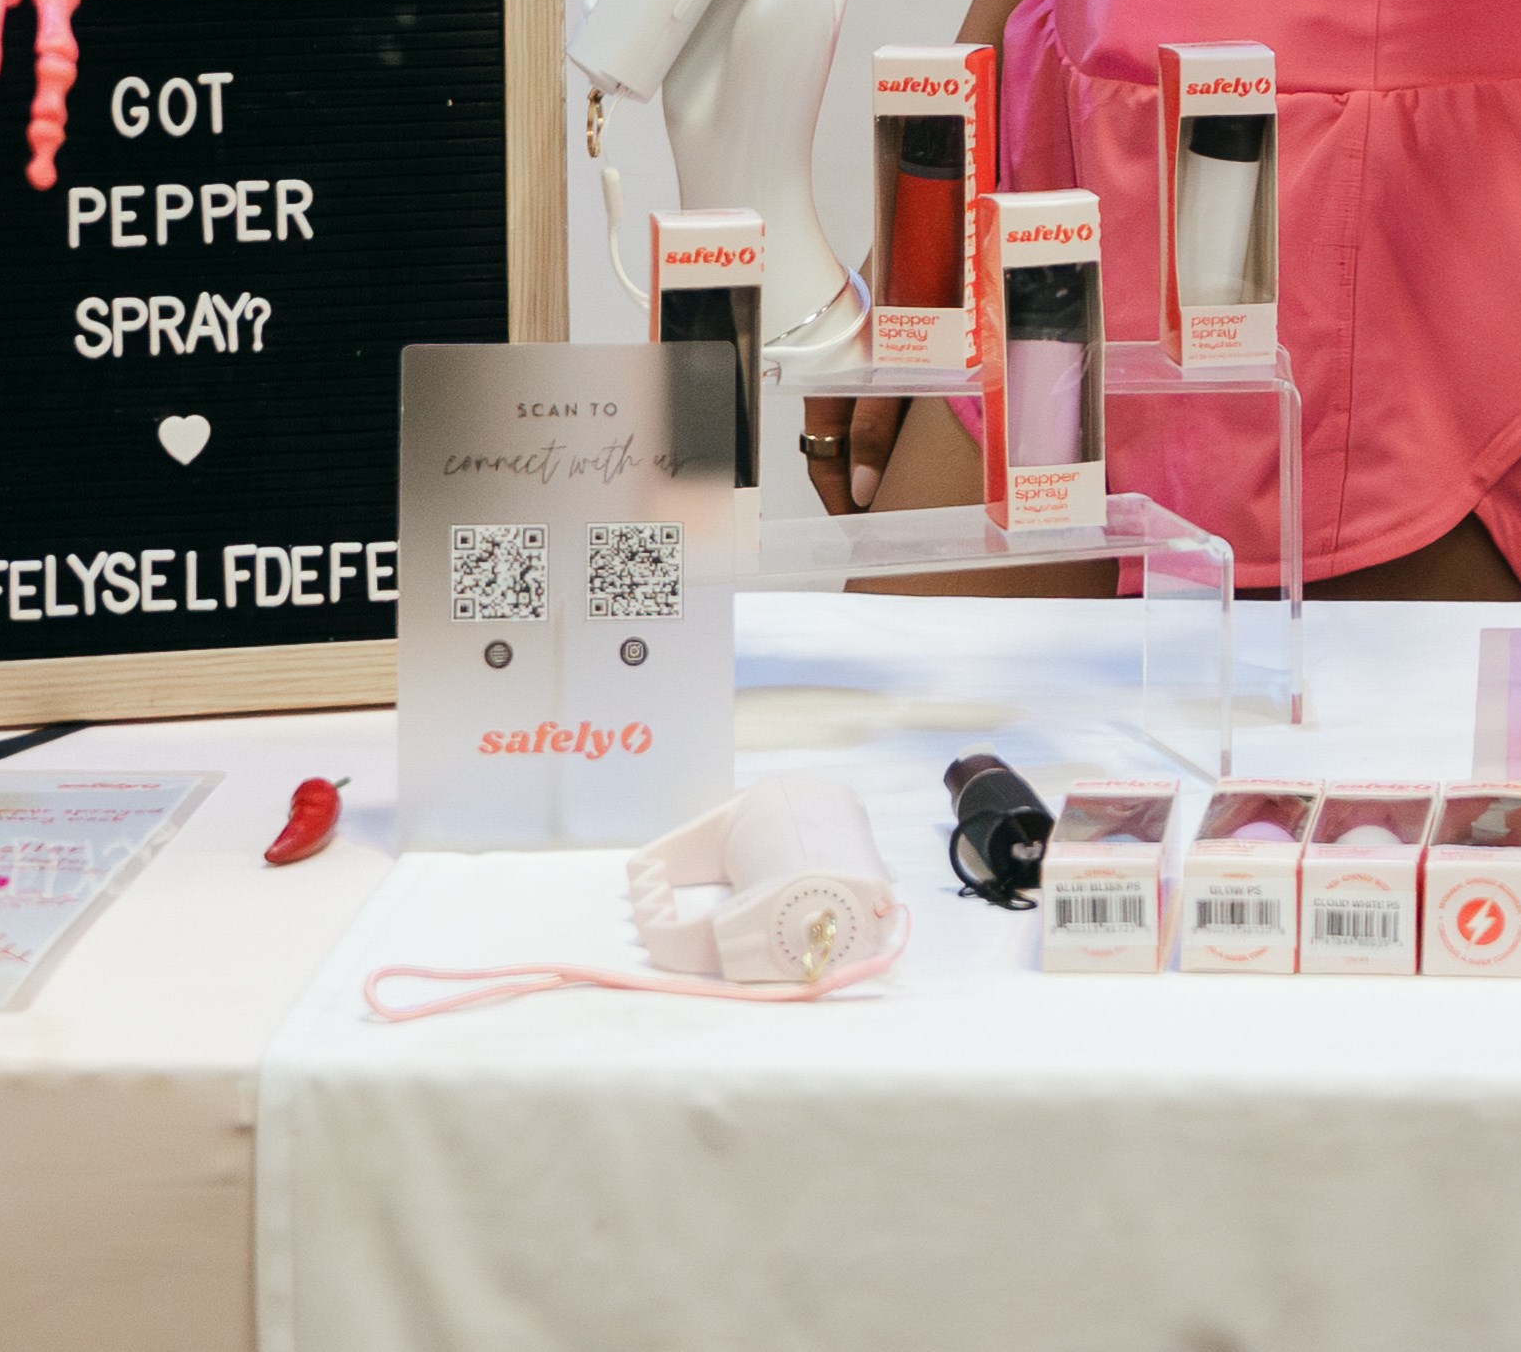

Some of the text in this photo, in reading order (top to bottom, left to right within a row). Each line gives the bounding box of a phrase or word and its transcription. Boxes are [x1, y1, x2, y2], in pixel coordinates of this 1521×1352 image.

[876, 76, 941, 96] safely
[1185, 76, 1254, 97] safely
[110, 71, 235, 138] GOT
[67, 178, 315, 248] PEPPER
[1005, 223, 1074, 244] safely
[665, 245, 736, 268] safely
[73, 290, 272, 359] SPRAY?
[878, 313, 940, 327] pepper
[1191, 314, 1247, 328] pepper
[878, 327, 928, 342] spray
[1191, 328, 1237, 341] spray
[516, 401, 619, 419] SCAN TO
[443, 438, 567, 485] connect
[568, 432, 643, 485] with
[1014, 471, 1080, 488] pepper
[1014, 486, 1069, 503] spray
[478, 720, 615, 760] safely
[1247, 885, 1263, 896] PS
[1313, 899, 1350, 908] CLOUD
[1386, 900, 1401, 910] PS
